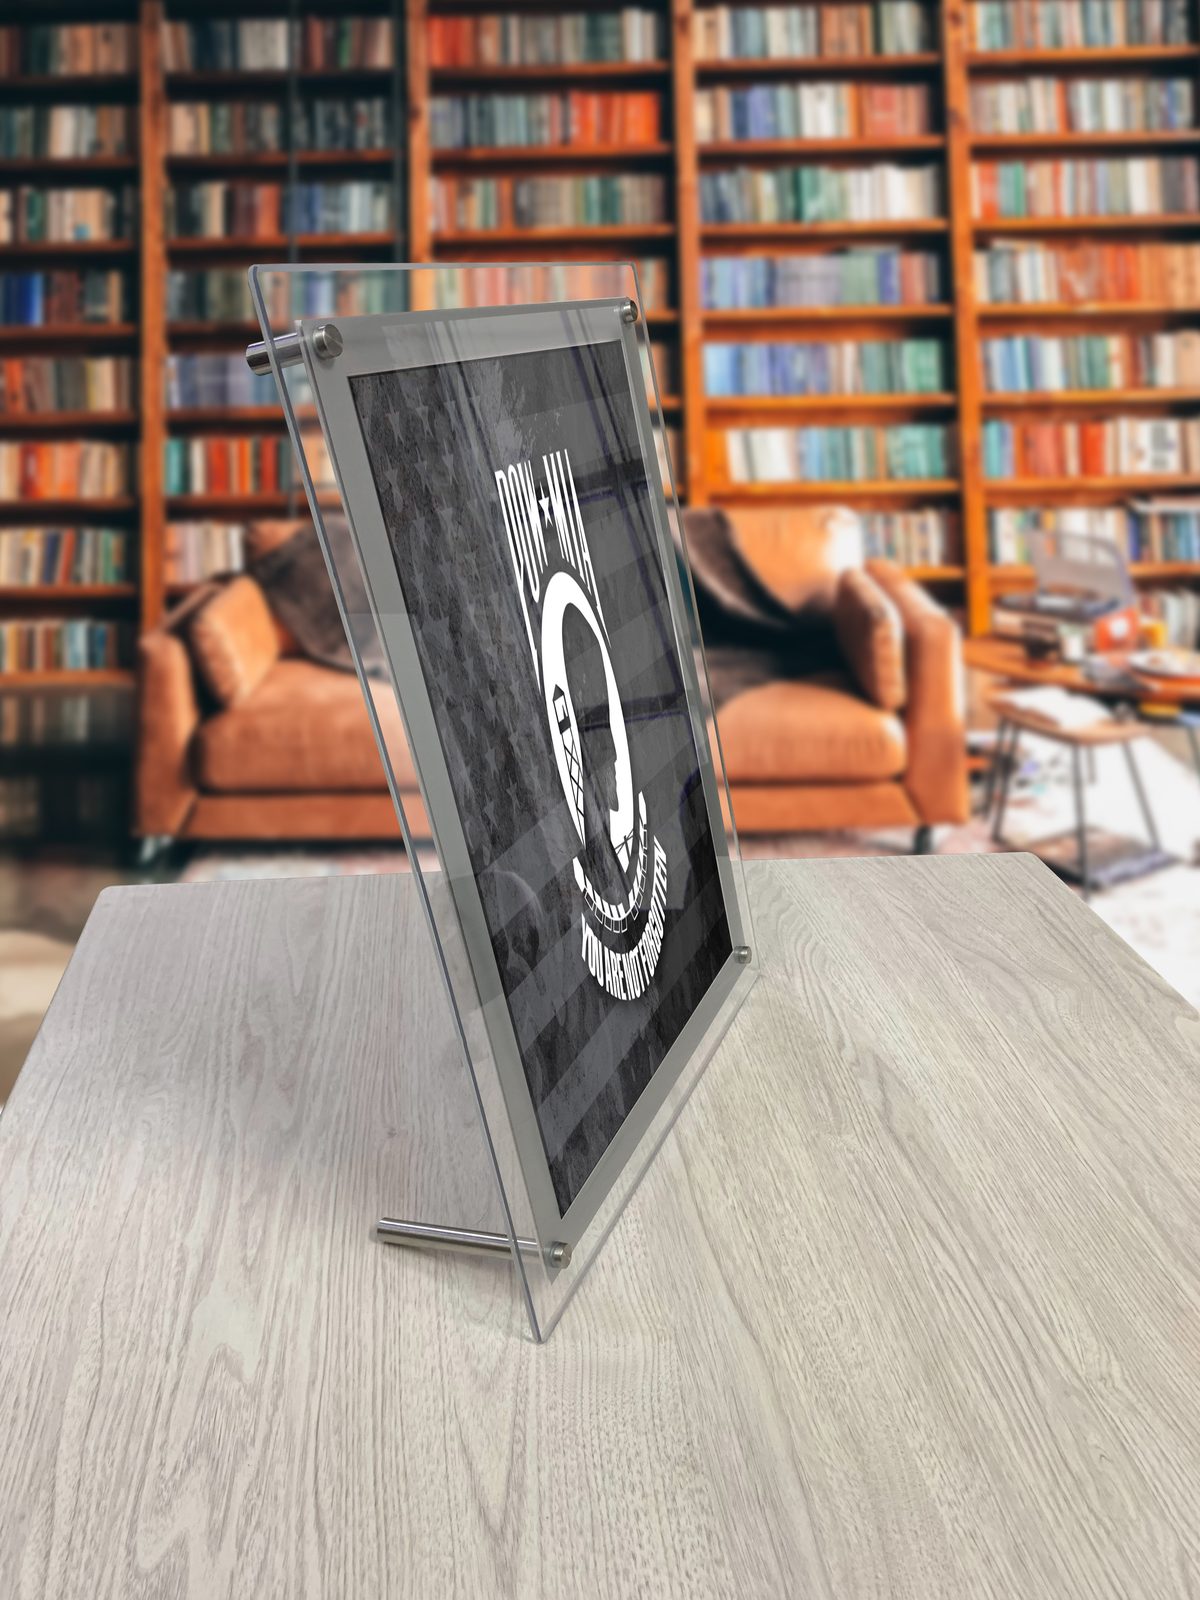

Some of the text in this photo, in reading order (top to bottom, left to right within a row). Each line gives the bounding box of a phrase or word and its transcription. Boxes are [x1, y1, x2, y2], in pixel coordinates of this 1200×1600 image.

[494, 448, 612, 695] POW MIA
[581, 834, 667, 1000] YOU ARE NOT FORGOTTEN
